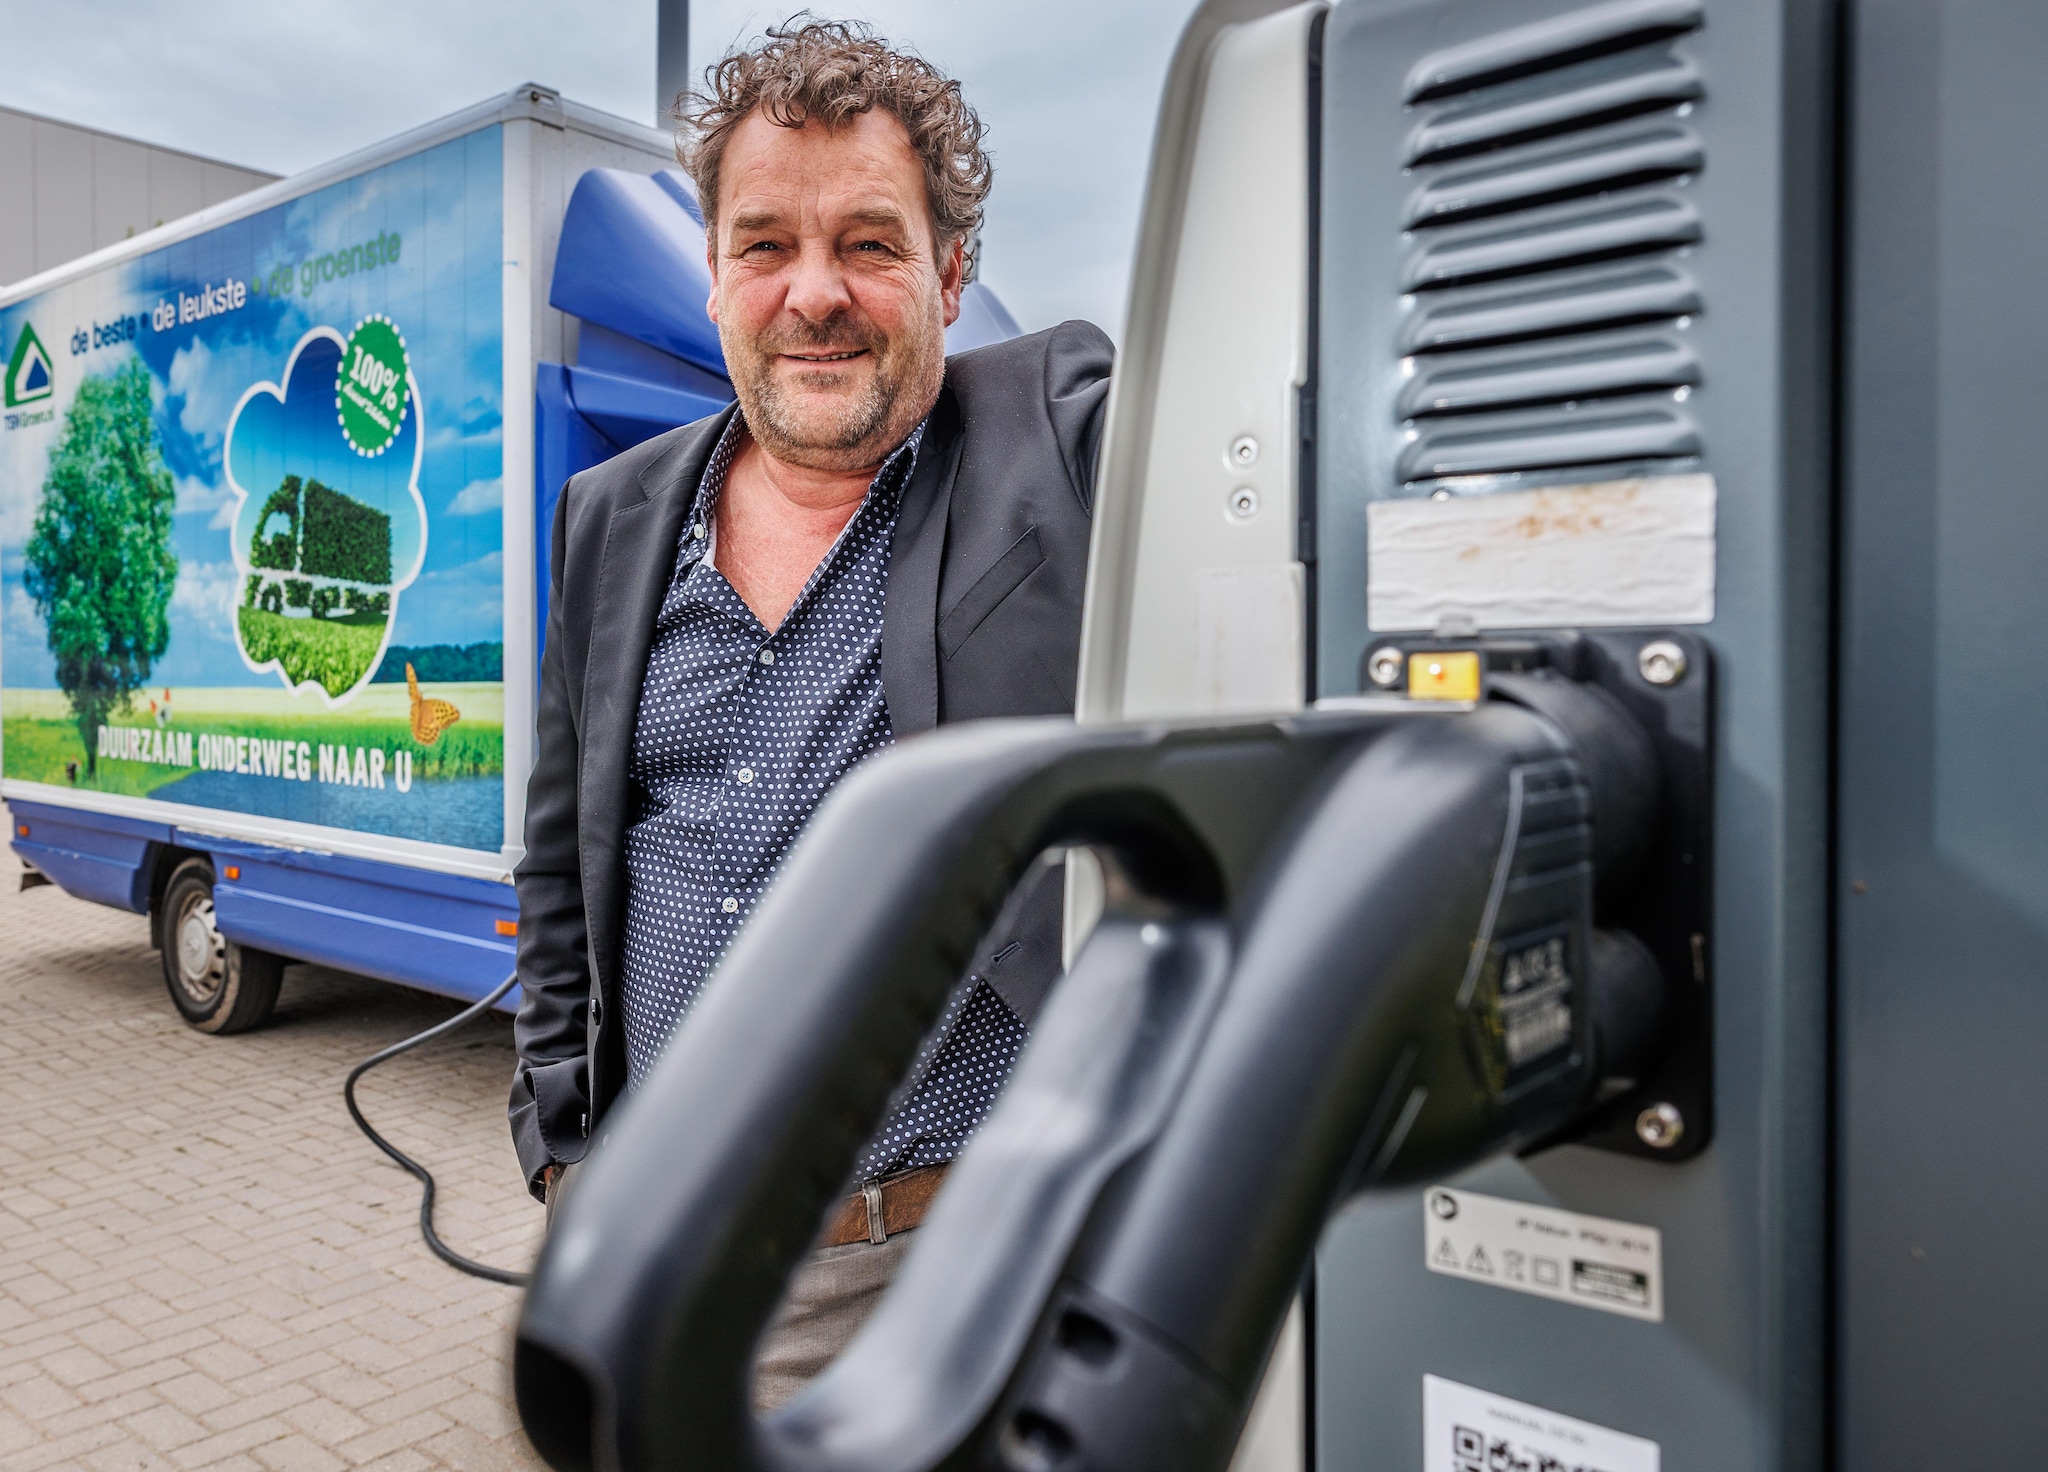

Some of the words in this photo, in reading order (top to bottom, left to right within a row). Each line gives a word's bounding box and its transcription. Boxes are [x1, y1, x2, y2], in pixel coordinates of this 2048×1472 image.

[71, 326, 89, 356] de
[93, 314, 137, 350] beste
[152, 298, 176, 333] de
[178, 277, 247, 325] leukste
[267, 261, 294, 298] de
[301, 230, 402, 297] groenste
[348, 344, 401, 412] 100%
[97, 724, 193, 768] DUURZAAM
[198, 733, 312, 782] ONDERWEG
[317, 743, 386, 790] NAAR
[394, 750, 413, 794] U
